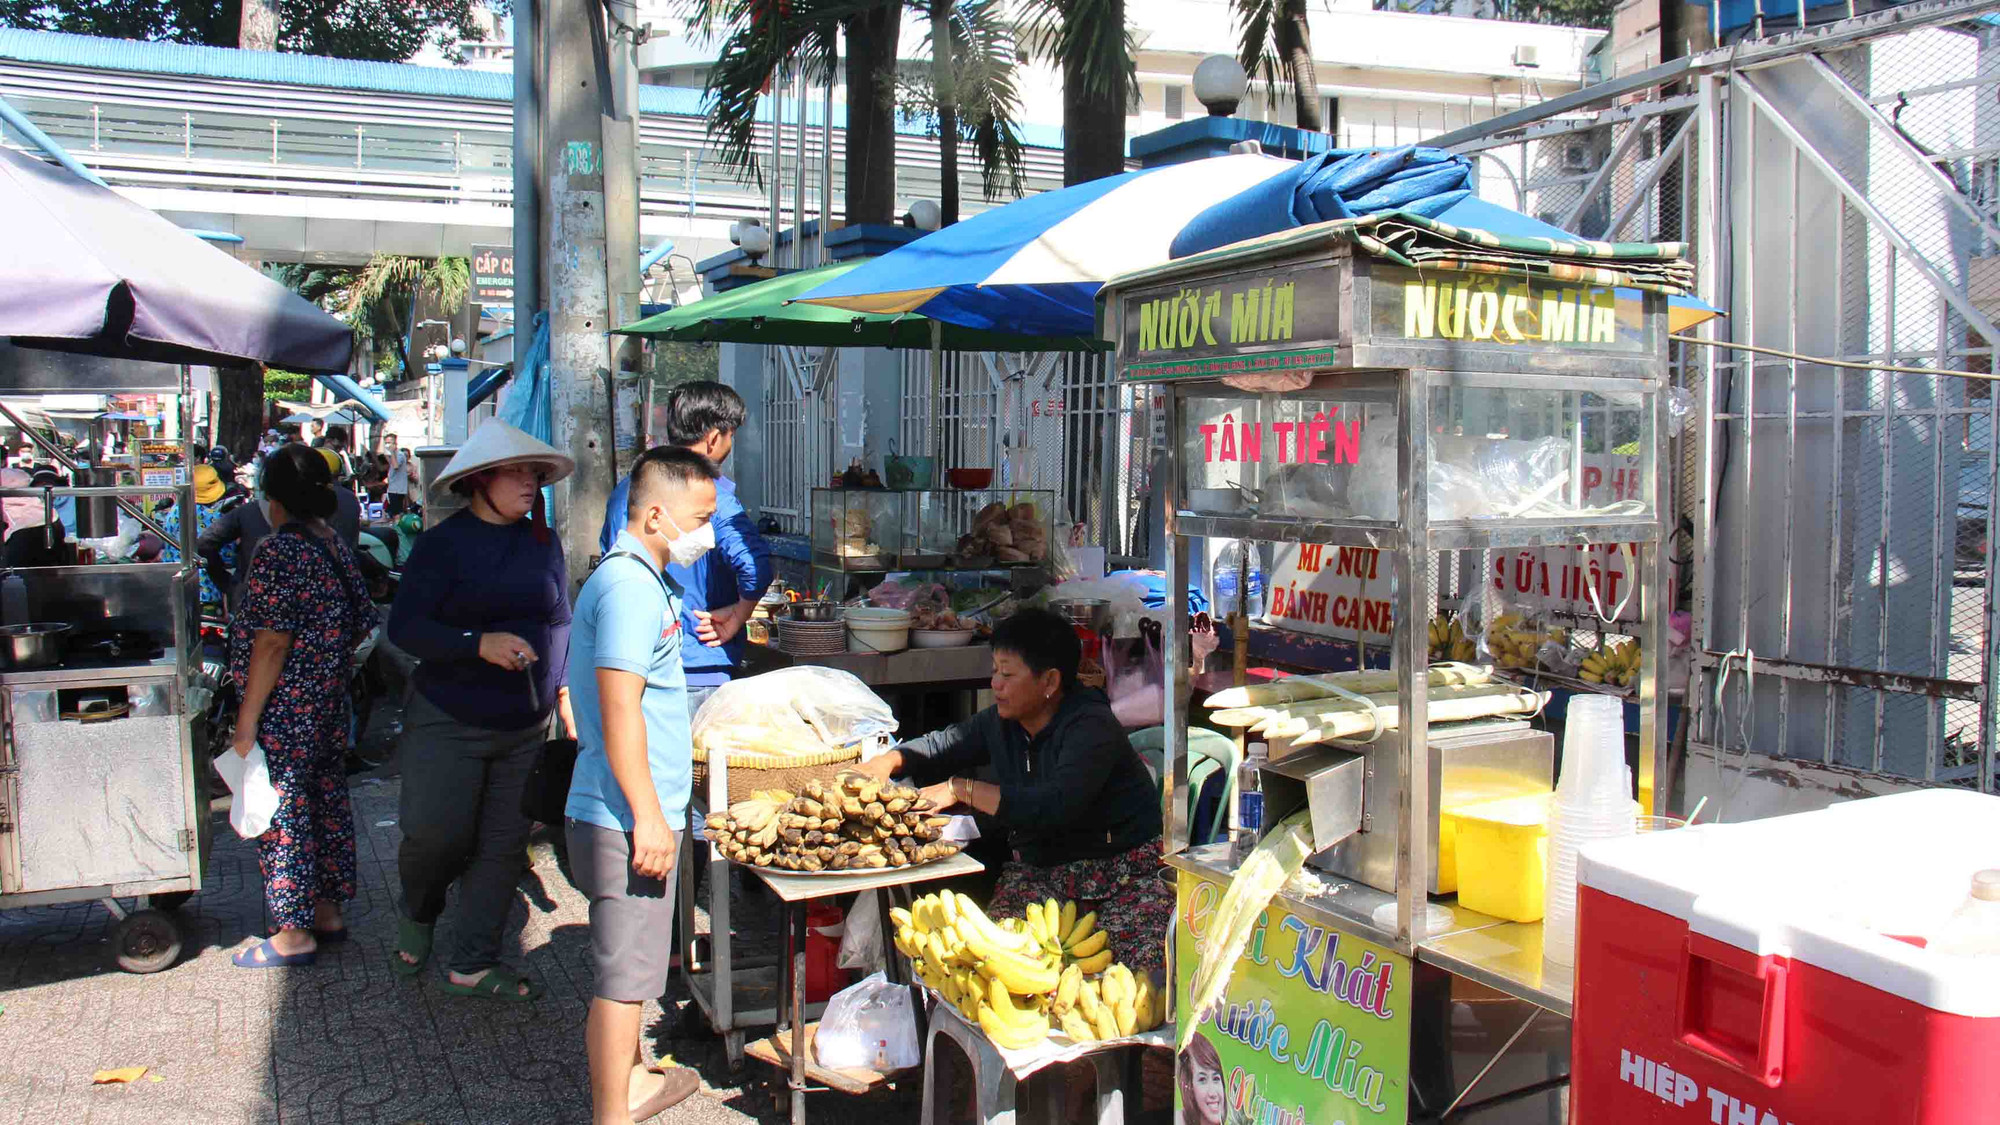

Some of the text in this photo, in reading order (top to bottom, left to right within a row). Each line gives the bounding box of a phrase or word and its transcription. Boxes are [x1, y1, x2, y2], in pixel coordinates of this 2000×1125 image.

[475, 251, 499, 274] CẤP
[1139, 278, 1296, 352] NƯỚC MÍA
[1404, 274, 1616, 343] NƯỚC MÍA
[1199, 406, 1361, 464] TÂN TIẾN
[1271, 580, 1329, 625] BÁNH
[1275, 913, 1394, 1020] Khát
[1294, 1018, 1386, 1113] Mía
[1619, 1047, 1796, 1125] HIỆP THÀ
